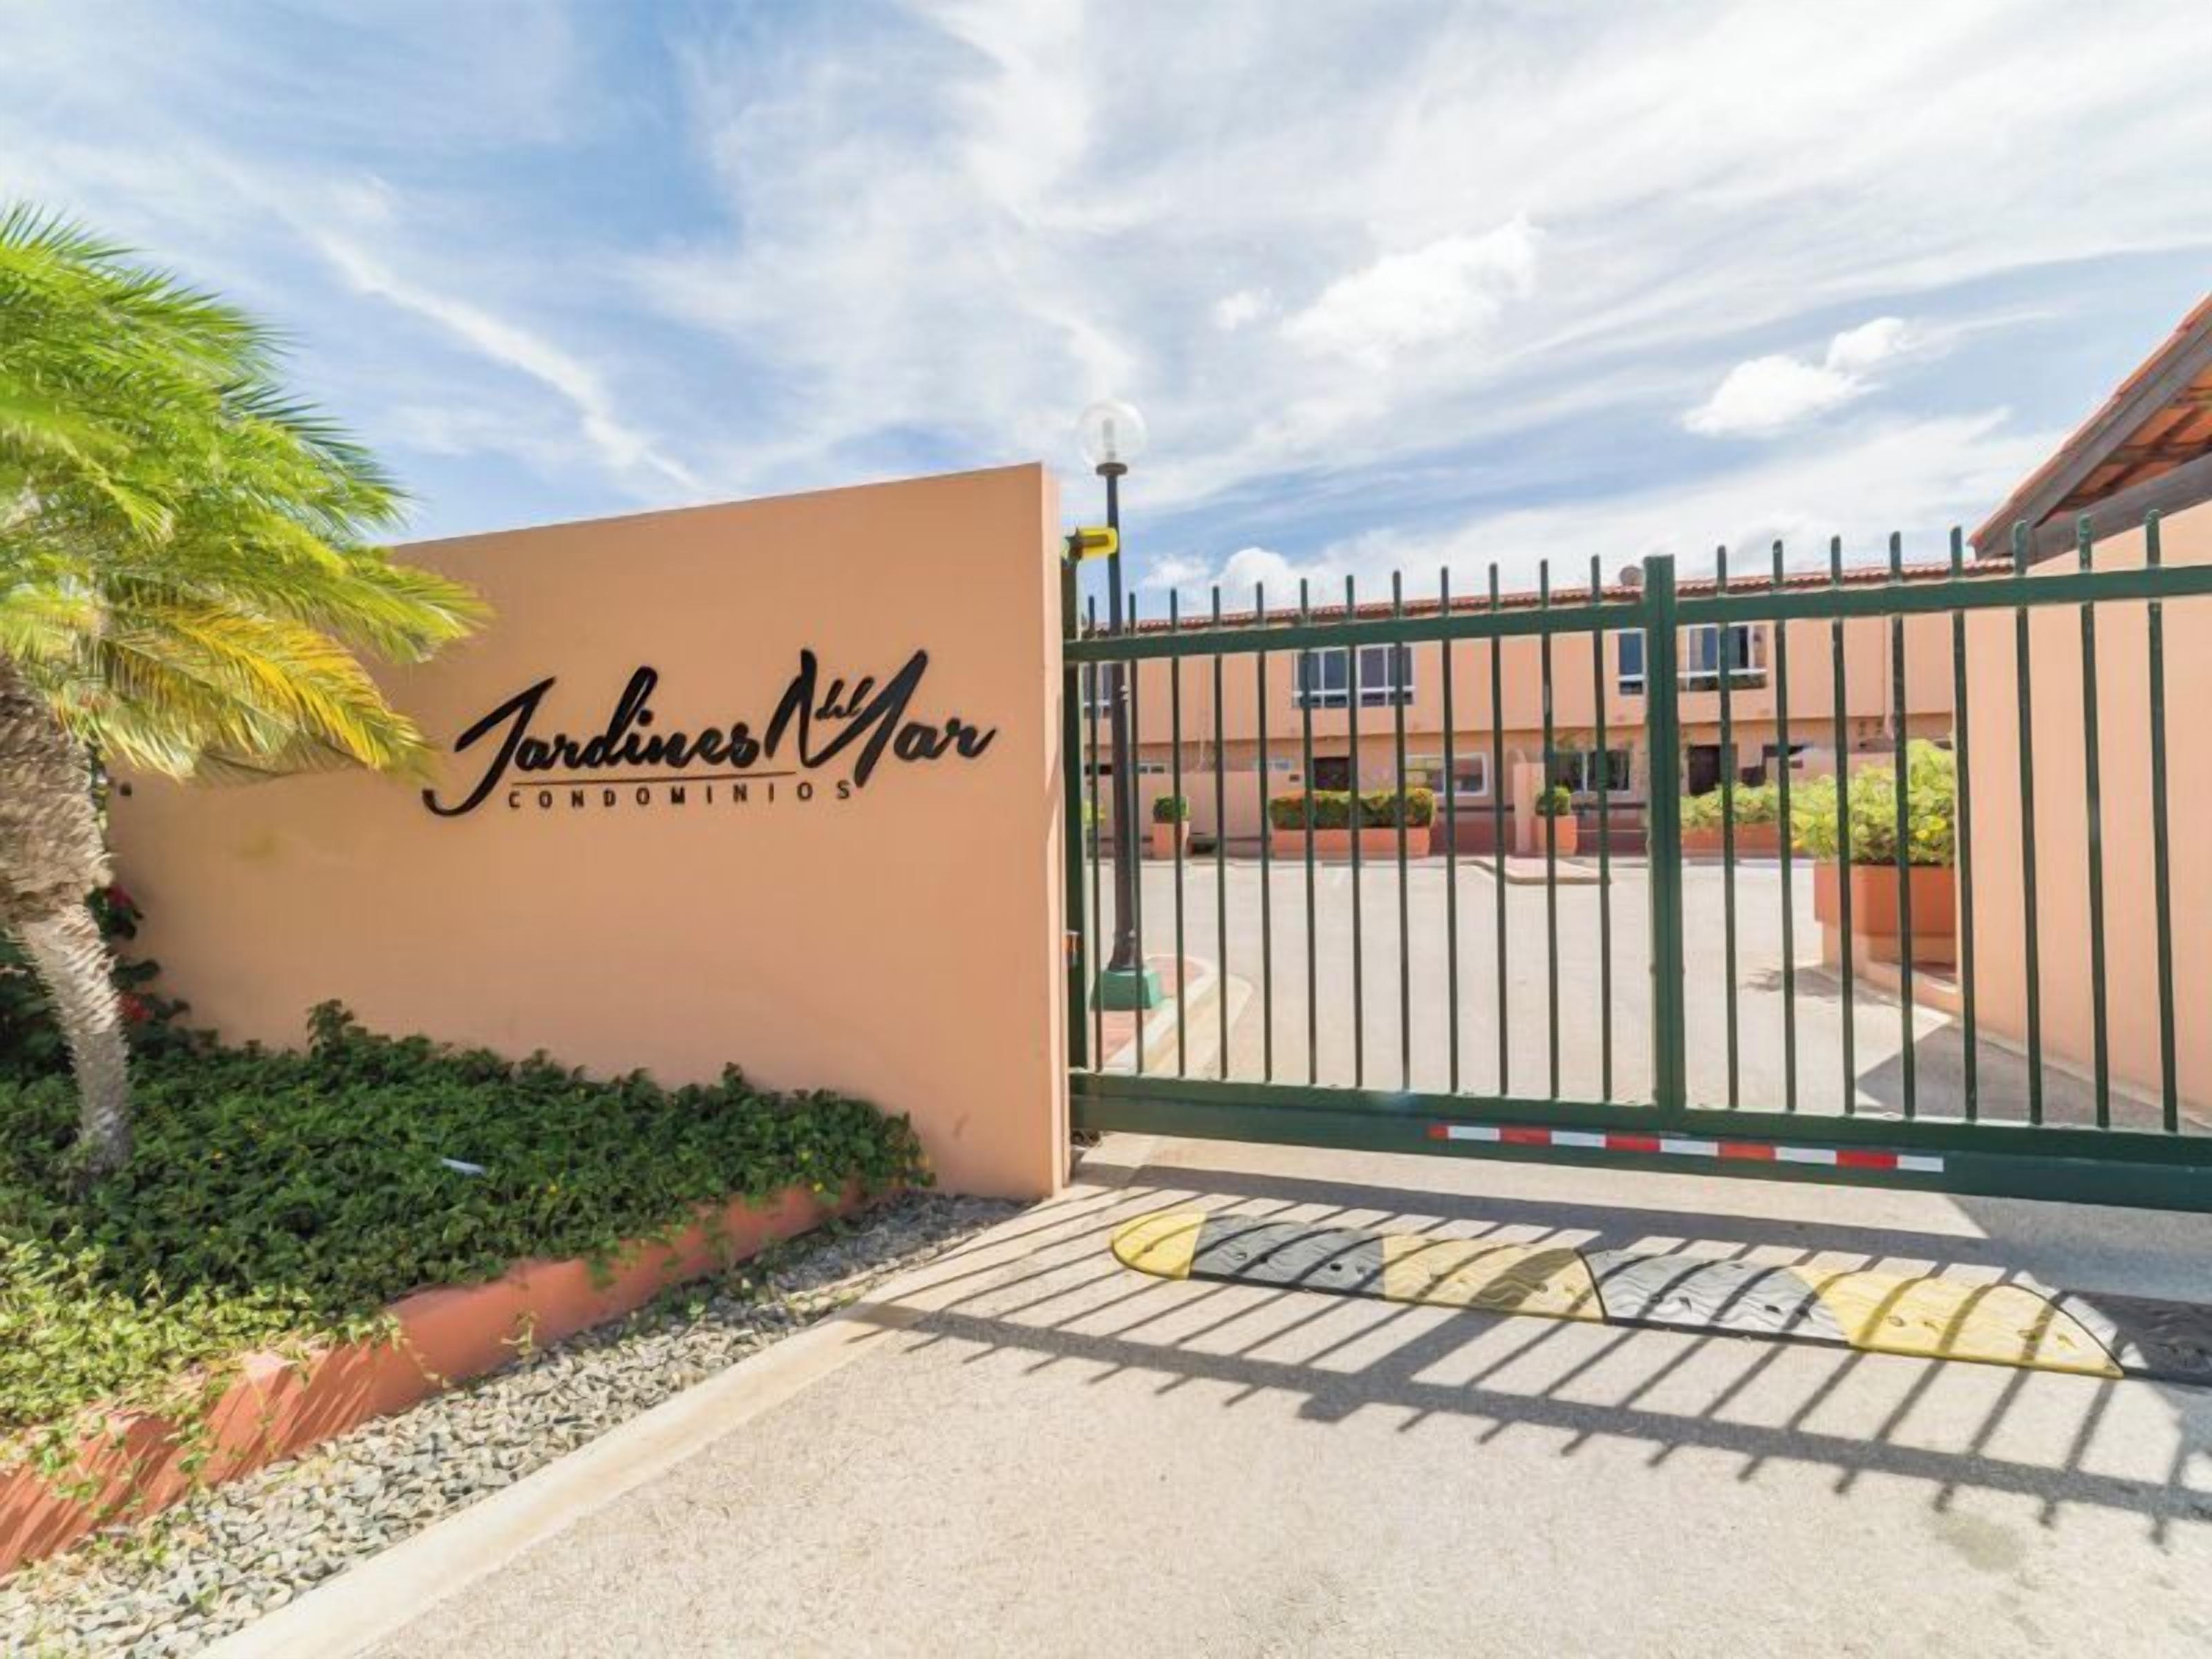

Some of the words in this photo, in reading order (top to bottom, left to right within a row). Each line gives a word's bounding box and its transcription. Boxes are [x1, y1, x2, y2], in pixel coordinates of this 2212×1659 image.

[422, 666, 760, 816] Jardines
[765, 649, 996, 787] Mar
[815, 677, 874, 720] del
[508, 780, 851, 808] CONDOMINIOS
